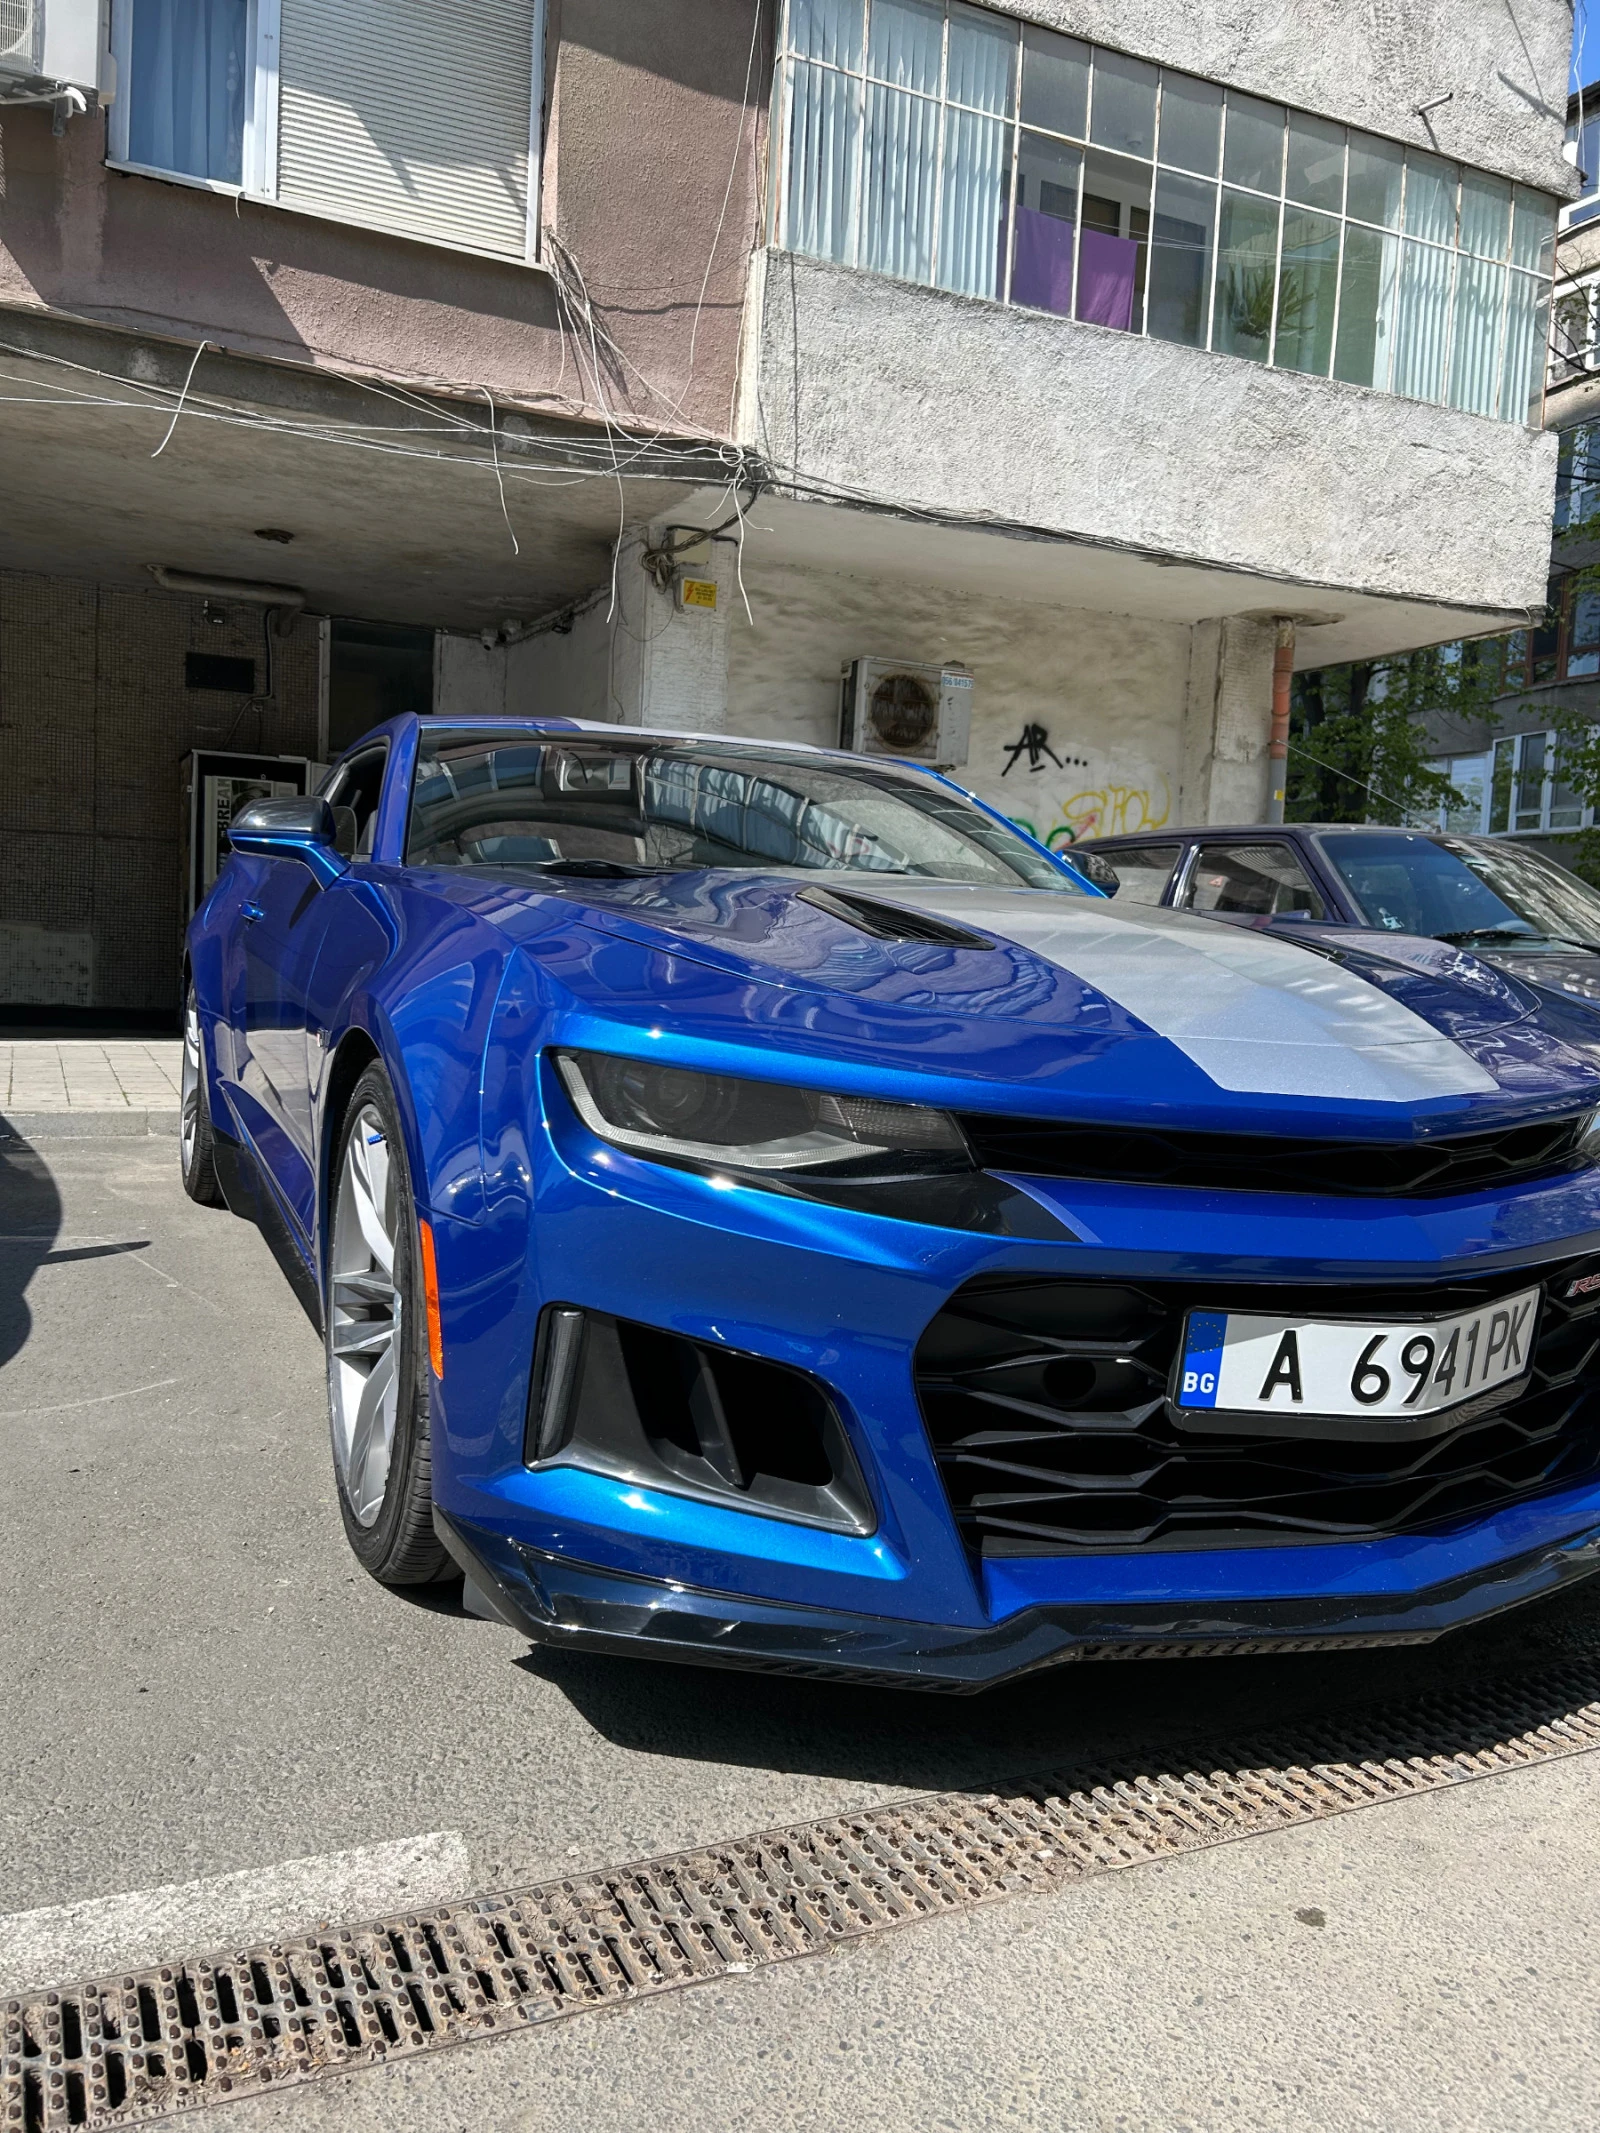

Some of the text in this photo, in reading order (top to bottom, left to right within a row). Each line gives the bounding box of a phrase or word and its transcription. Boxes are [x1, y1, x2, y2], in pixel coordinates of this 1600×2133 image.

[1258, 1329, 1304, 1404] A
[1183, 1371, 1215, 1395] BG
[131, 2105, 167, 2118] 1433
